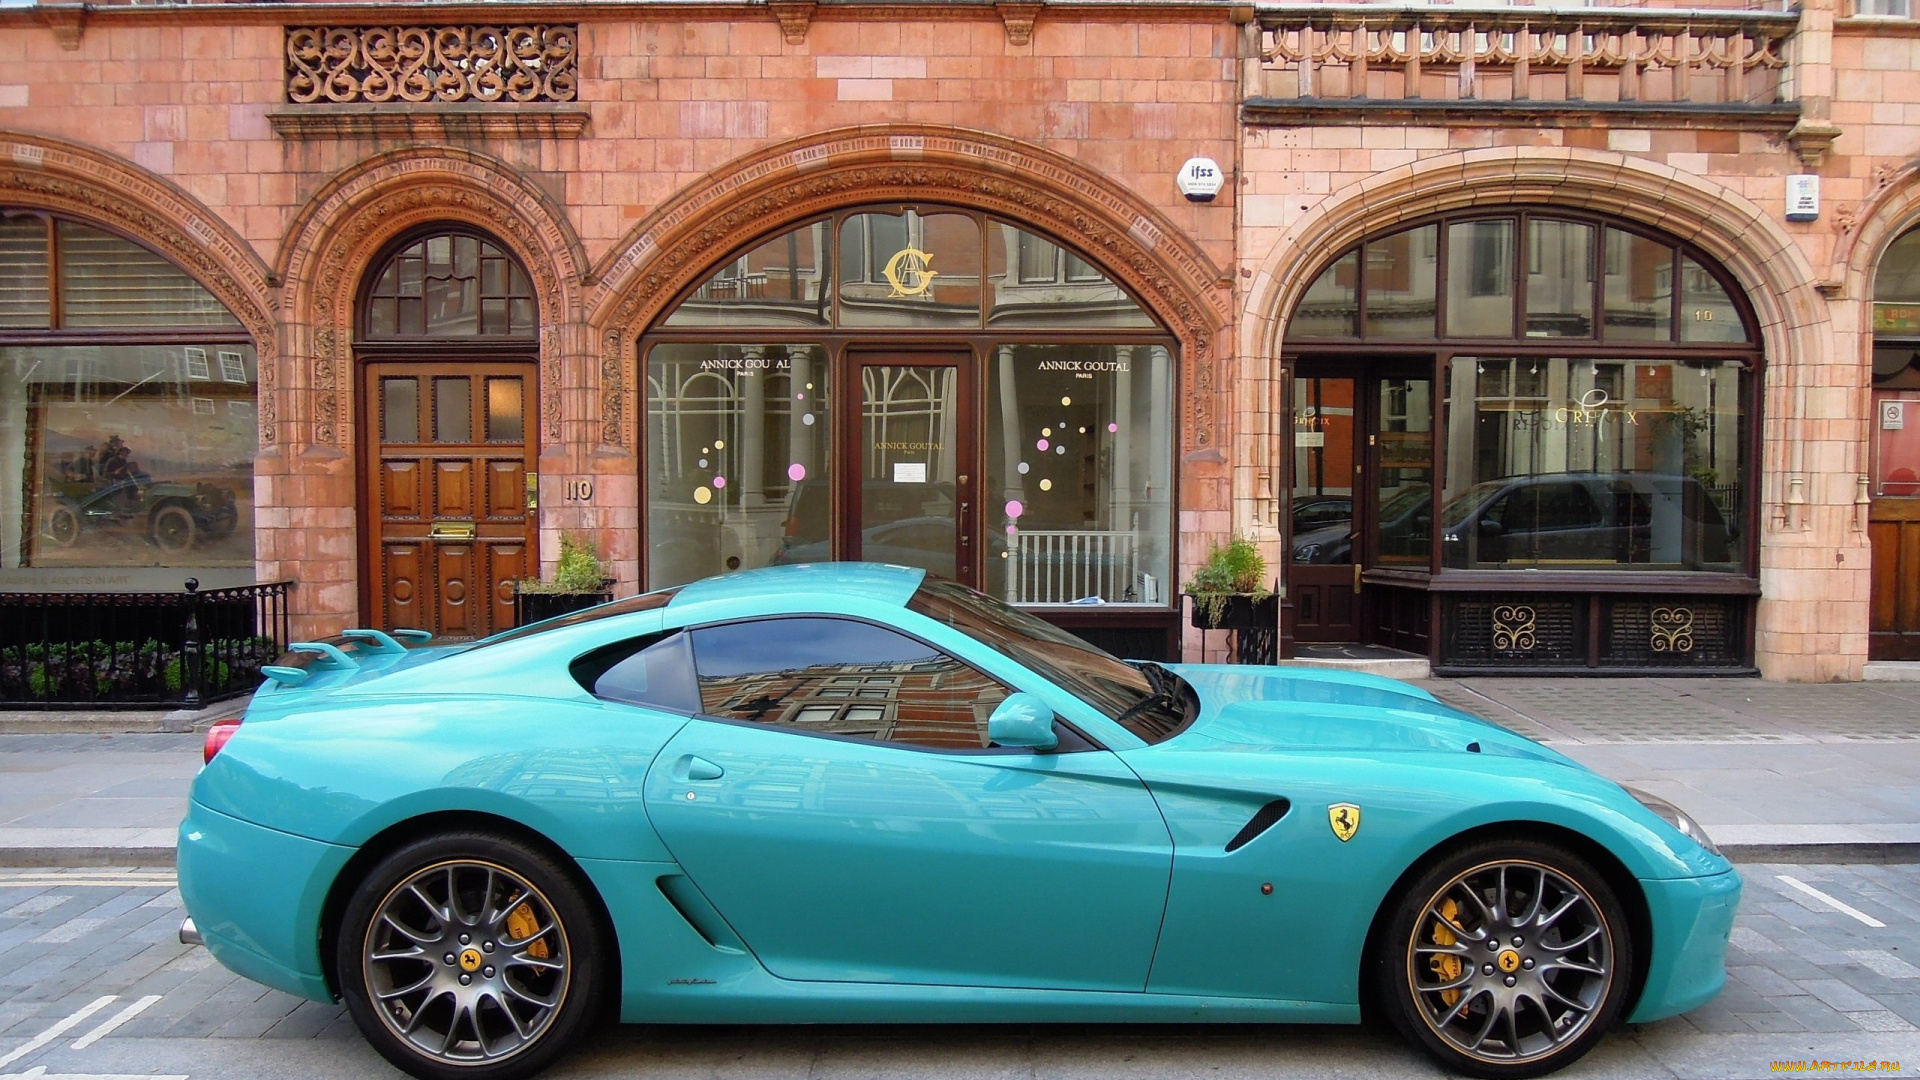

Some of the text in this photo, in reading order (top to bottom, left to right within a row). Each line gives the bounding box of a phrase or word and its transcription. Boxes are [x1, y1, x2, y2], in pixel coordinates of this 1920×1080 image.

[1191, 165, 1214, 180] ifss
[700, 359, 791, 369] ANNICK GOUAL
[1038, 360, 1130, 372] ANNICK GOUTAL
[874, 442, 945, 450] ANNICK GOUTAL
[565, 480, 593, 501] 110
[107, 575, 130, 584] ART
